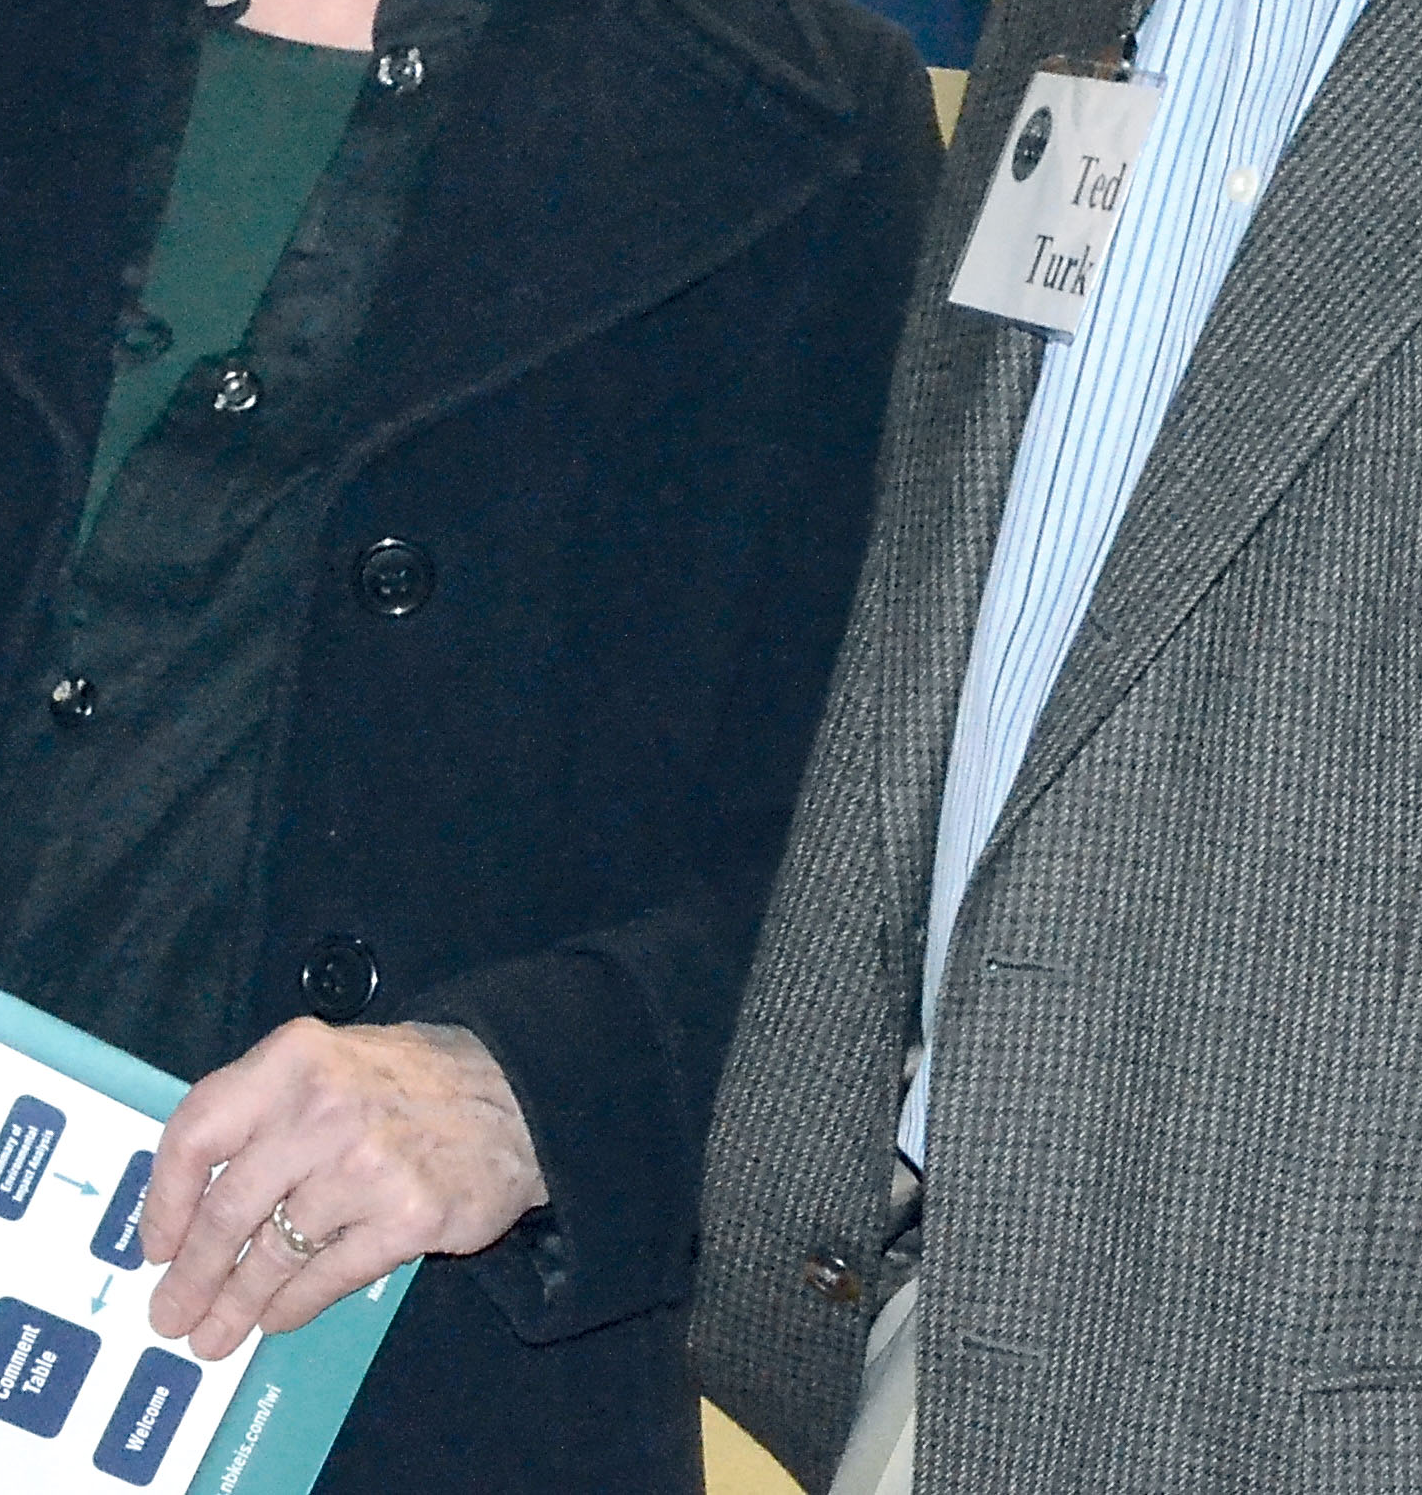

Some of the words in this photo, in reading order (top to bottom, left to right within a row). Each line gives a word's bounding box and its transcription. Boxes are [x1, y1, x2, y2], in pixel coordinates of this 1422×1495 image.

[1070, 155, 1127, 212] Ted
[0, 1125, 39, 1193] Environmental
[11, 1123, 23, 1137] of
[12, 1168, 36, 1203] Impact
[28, 1129, 55, 1170] Analysis
[21, 1350, 58, 1394] Table
[125, 1385, 170, 1451] Welcome
[220, 1383, 282, 1495] nbkeis.com/lwi
